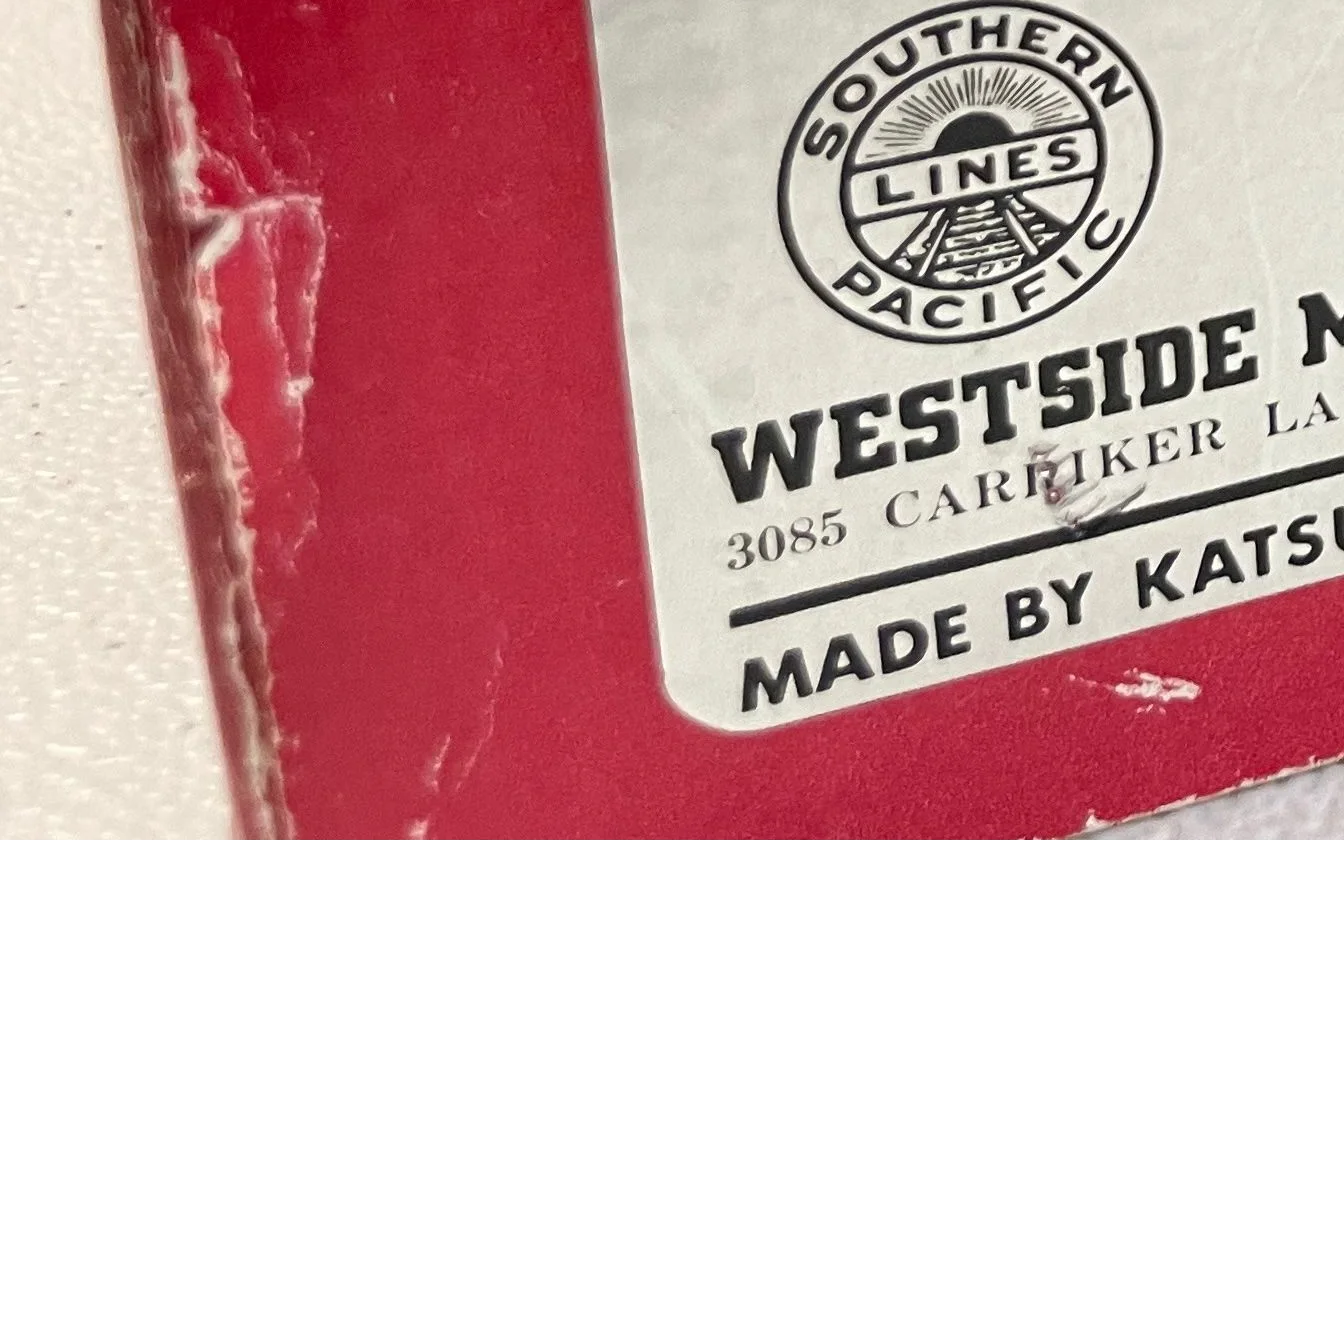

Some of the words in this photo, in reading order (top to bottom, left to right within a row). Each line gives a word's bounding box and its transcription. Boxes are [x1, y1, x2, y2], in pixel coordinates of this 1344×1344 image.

[802, 12, 1136, 162] SOUTHERN
[875, 135, 1082, 207] LINES
[830, 206, 1127, 330] PACIFIC
[709, 308, 1260, 505] WESTSIDE
[726, 510, 847, 570] 3085
[740, 604, 972, 714] MADE
[1003, 571, 1094, 642] BY
